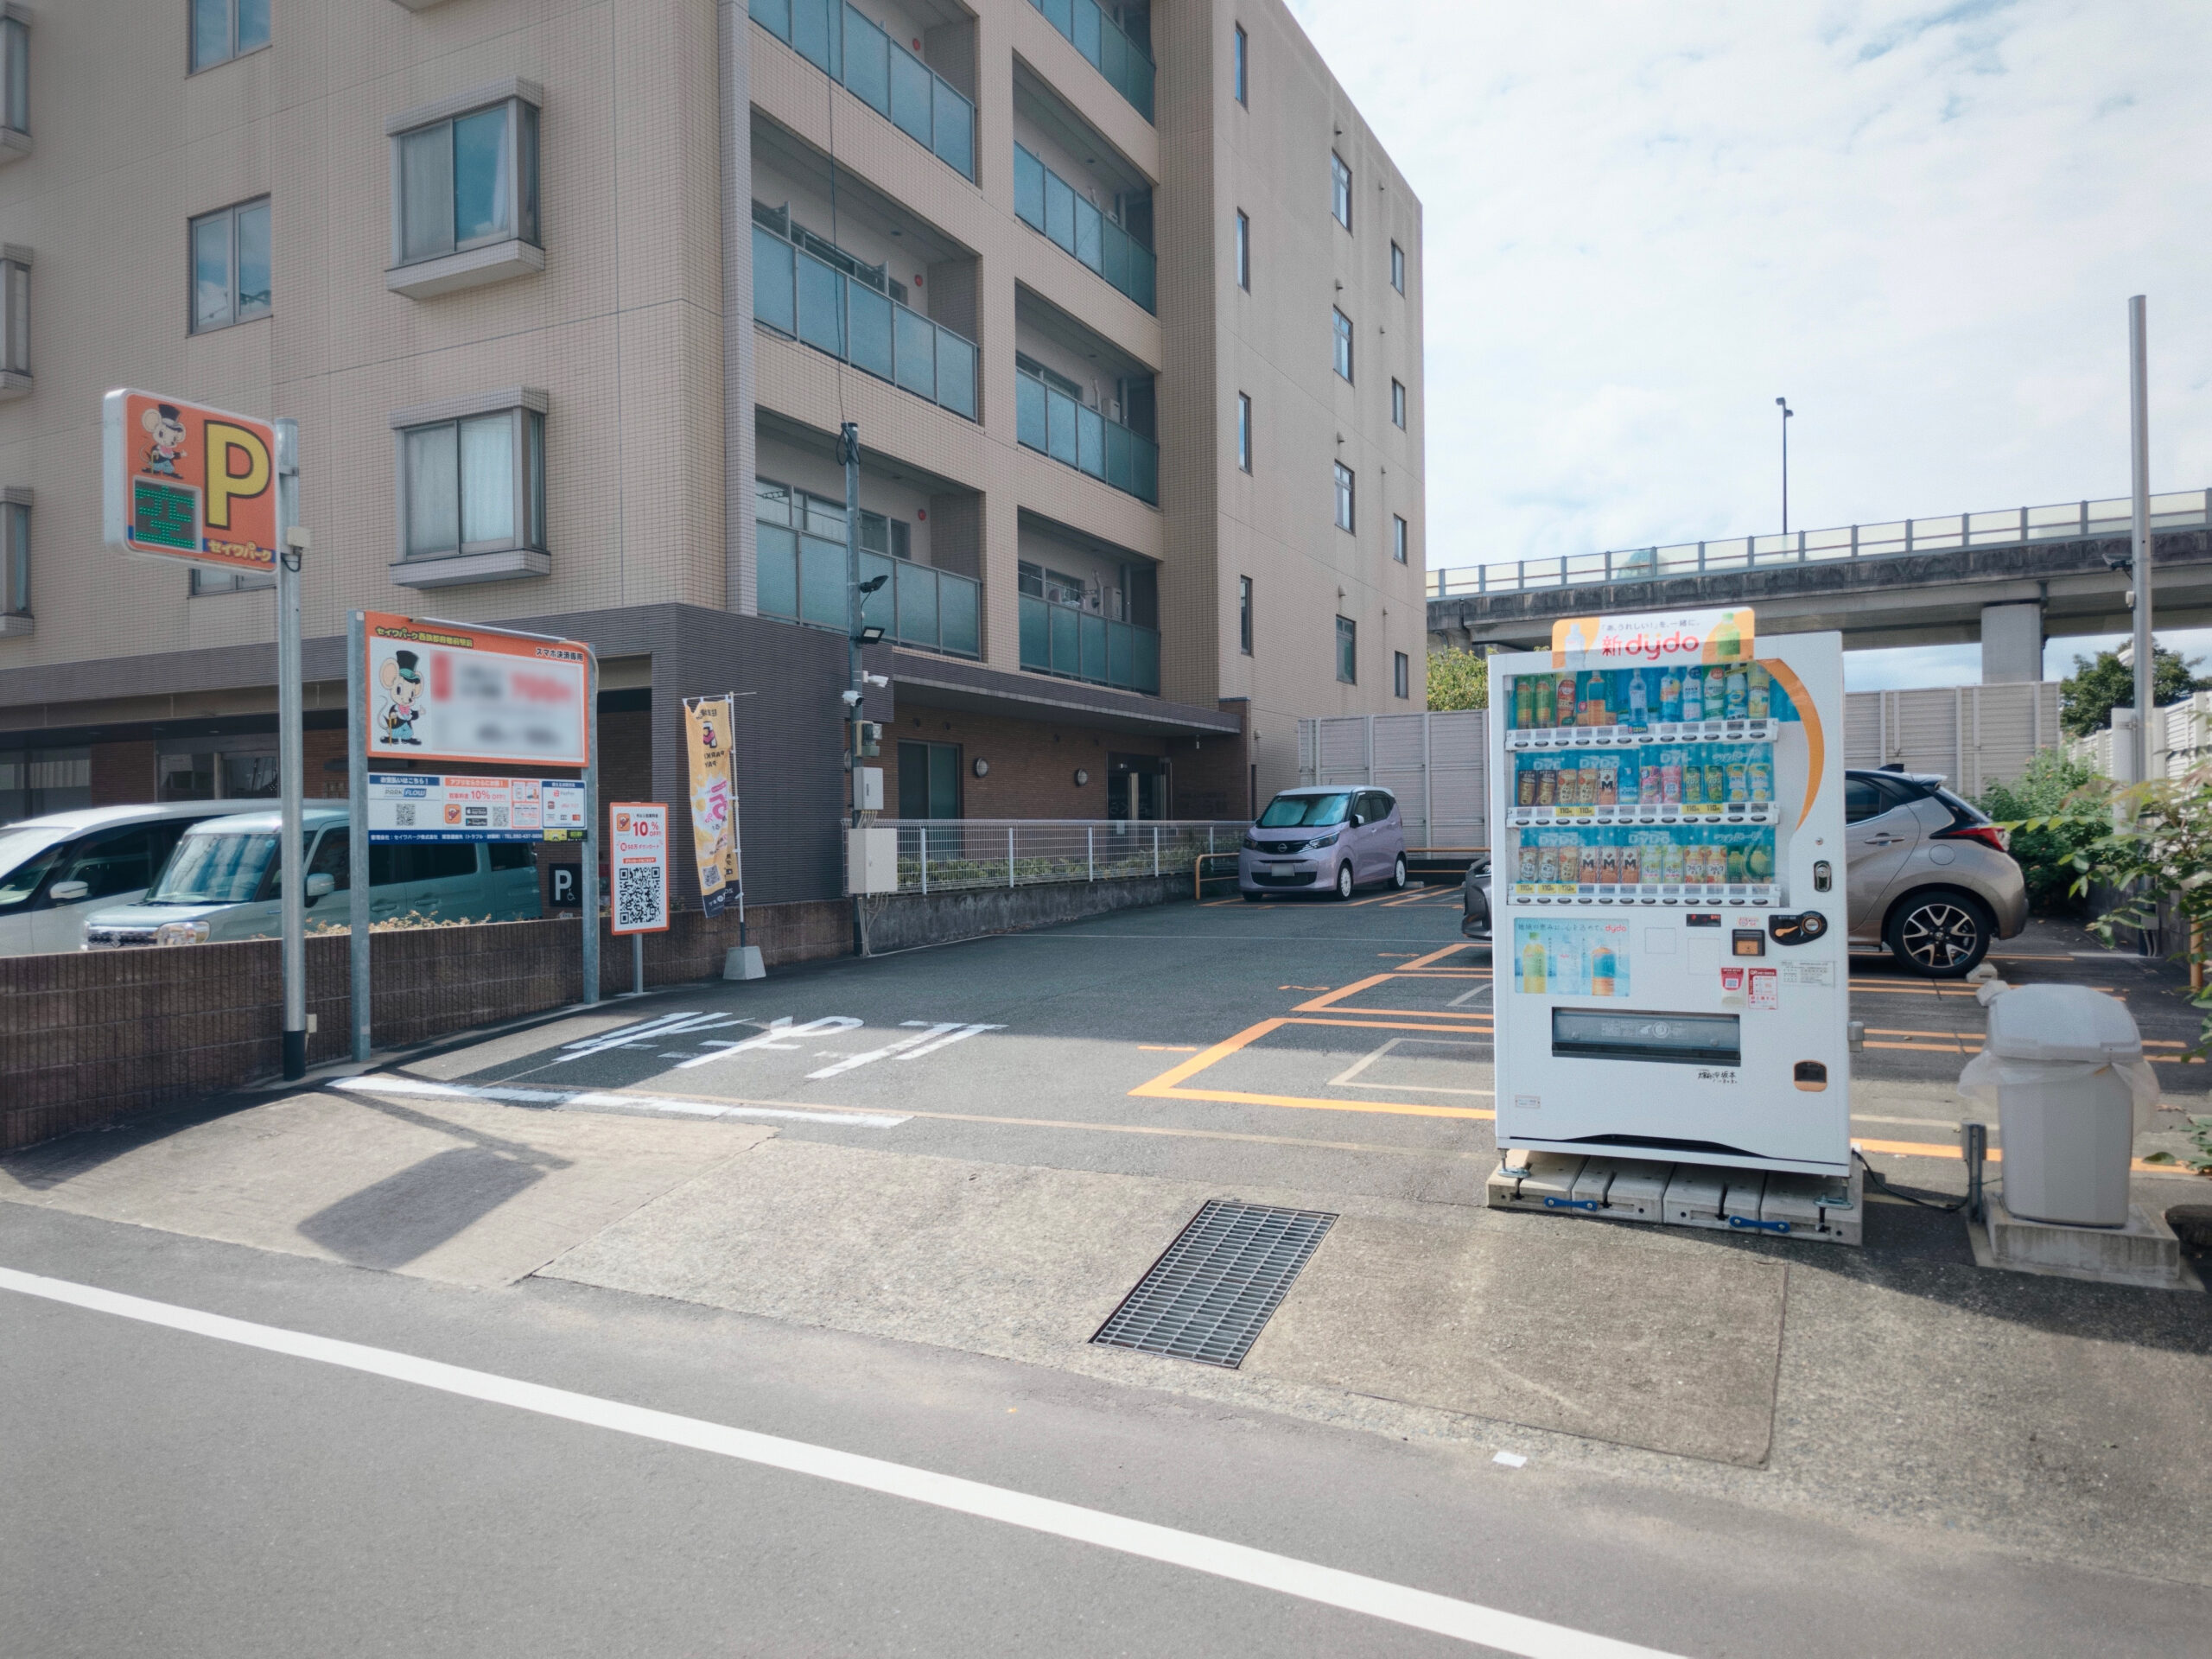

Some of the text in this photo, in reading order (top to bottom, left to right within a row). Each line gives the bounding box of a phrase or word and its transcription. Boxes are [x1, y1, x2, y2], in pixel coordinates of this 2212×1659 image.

[204, 420, 271, 531] P
[135, 486, 194, 549] 空
[207, 540, 272, 563] セイワパーク
[555, 870, 572, 900] P
[1605, 925, 1627, 933] dydo
